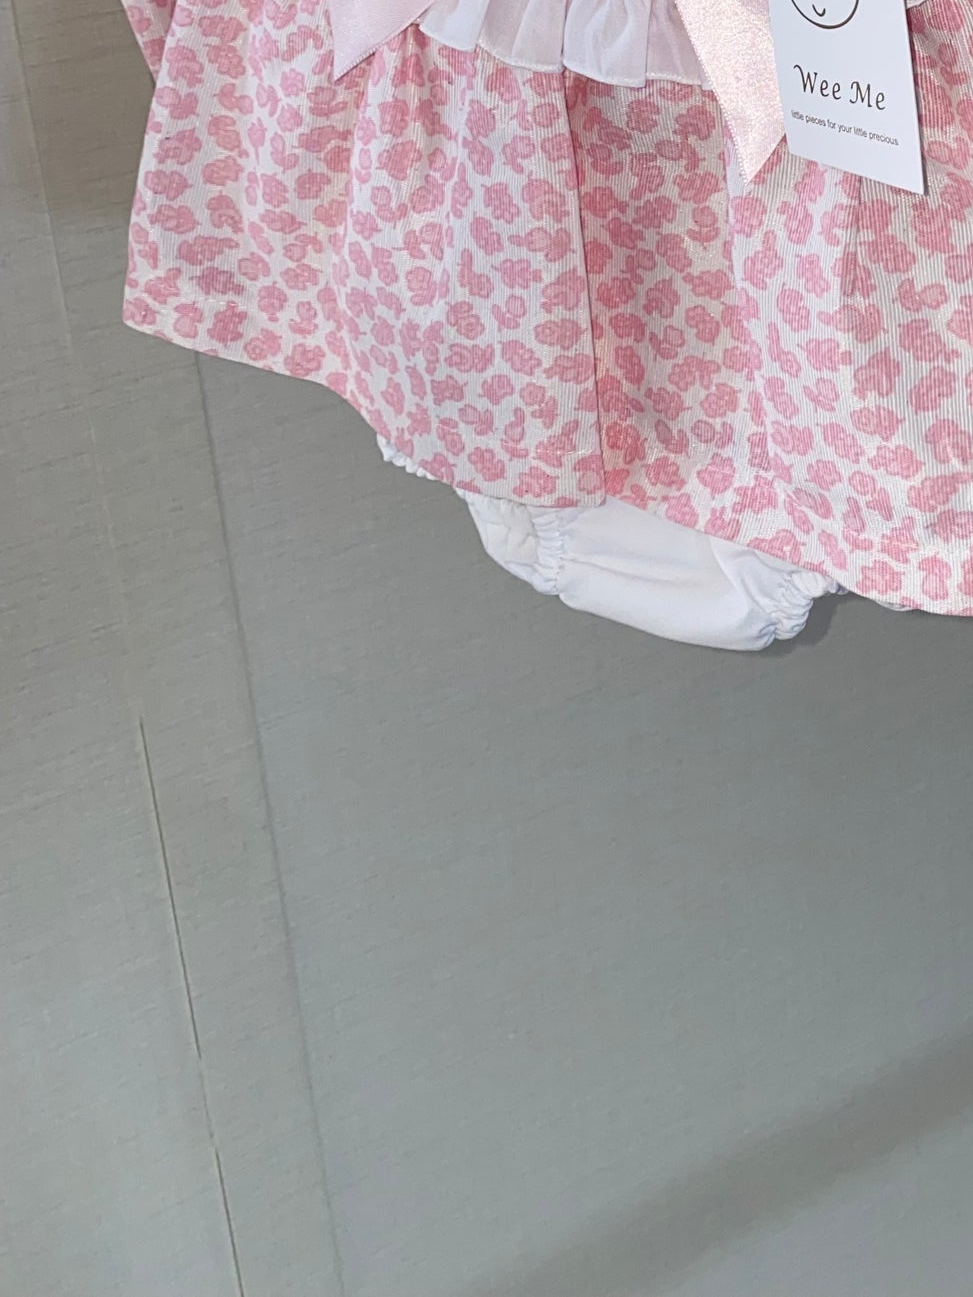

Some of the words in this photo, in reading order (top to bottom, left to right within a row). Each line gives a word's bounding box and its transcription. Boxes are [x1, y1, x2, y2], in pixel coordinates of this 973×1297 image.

[793, 64, 841, 100] Wee
[849, 81, 885, 110] Me
[791, 110, 804, 121] little
[805, 115, 826, 126] pieces
[827, 118, 836, 129] for
[837, 123, 852, 134] your
[853, 126, 867, 138] little
[868, 132, 899, 145] precious
